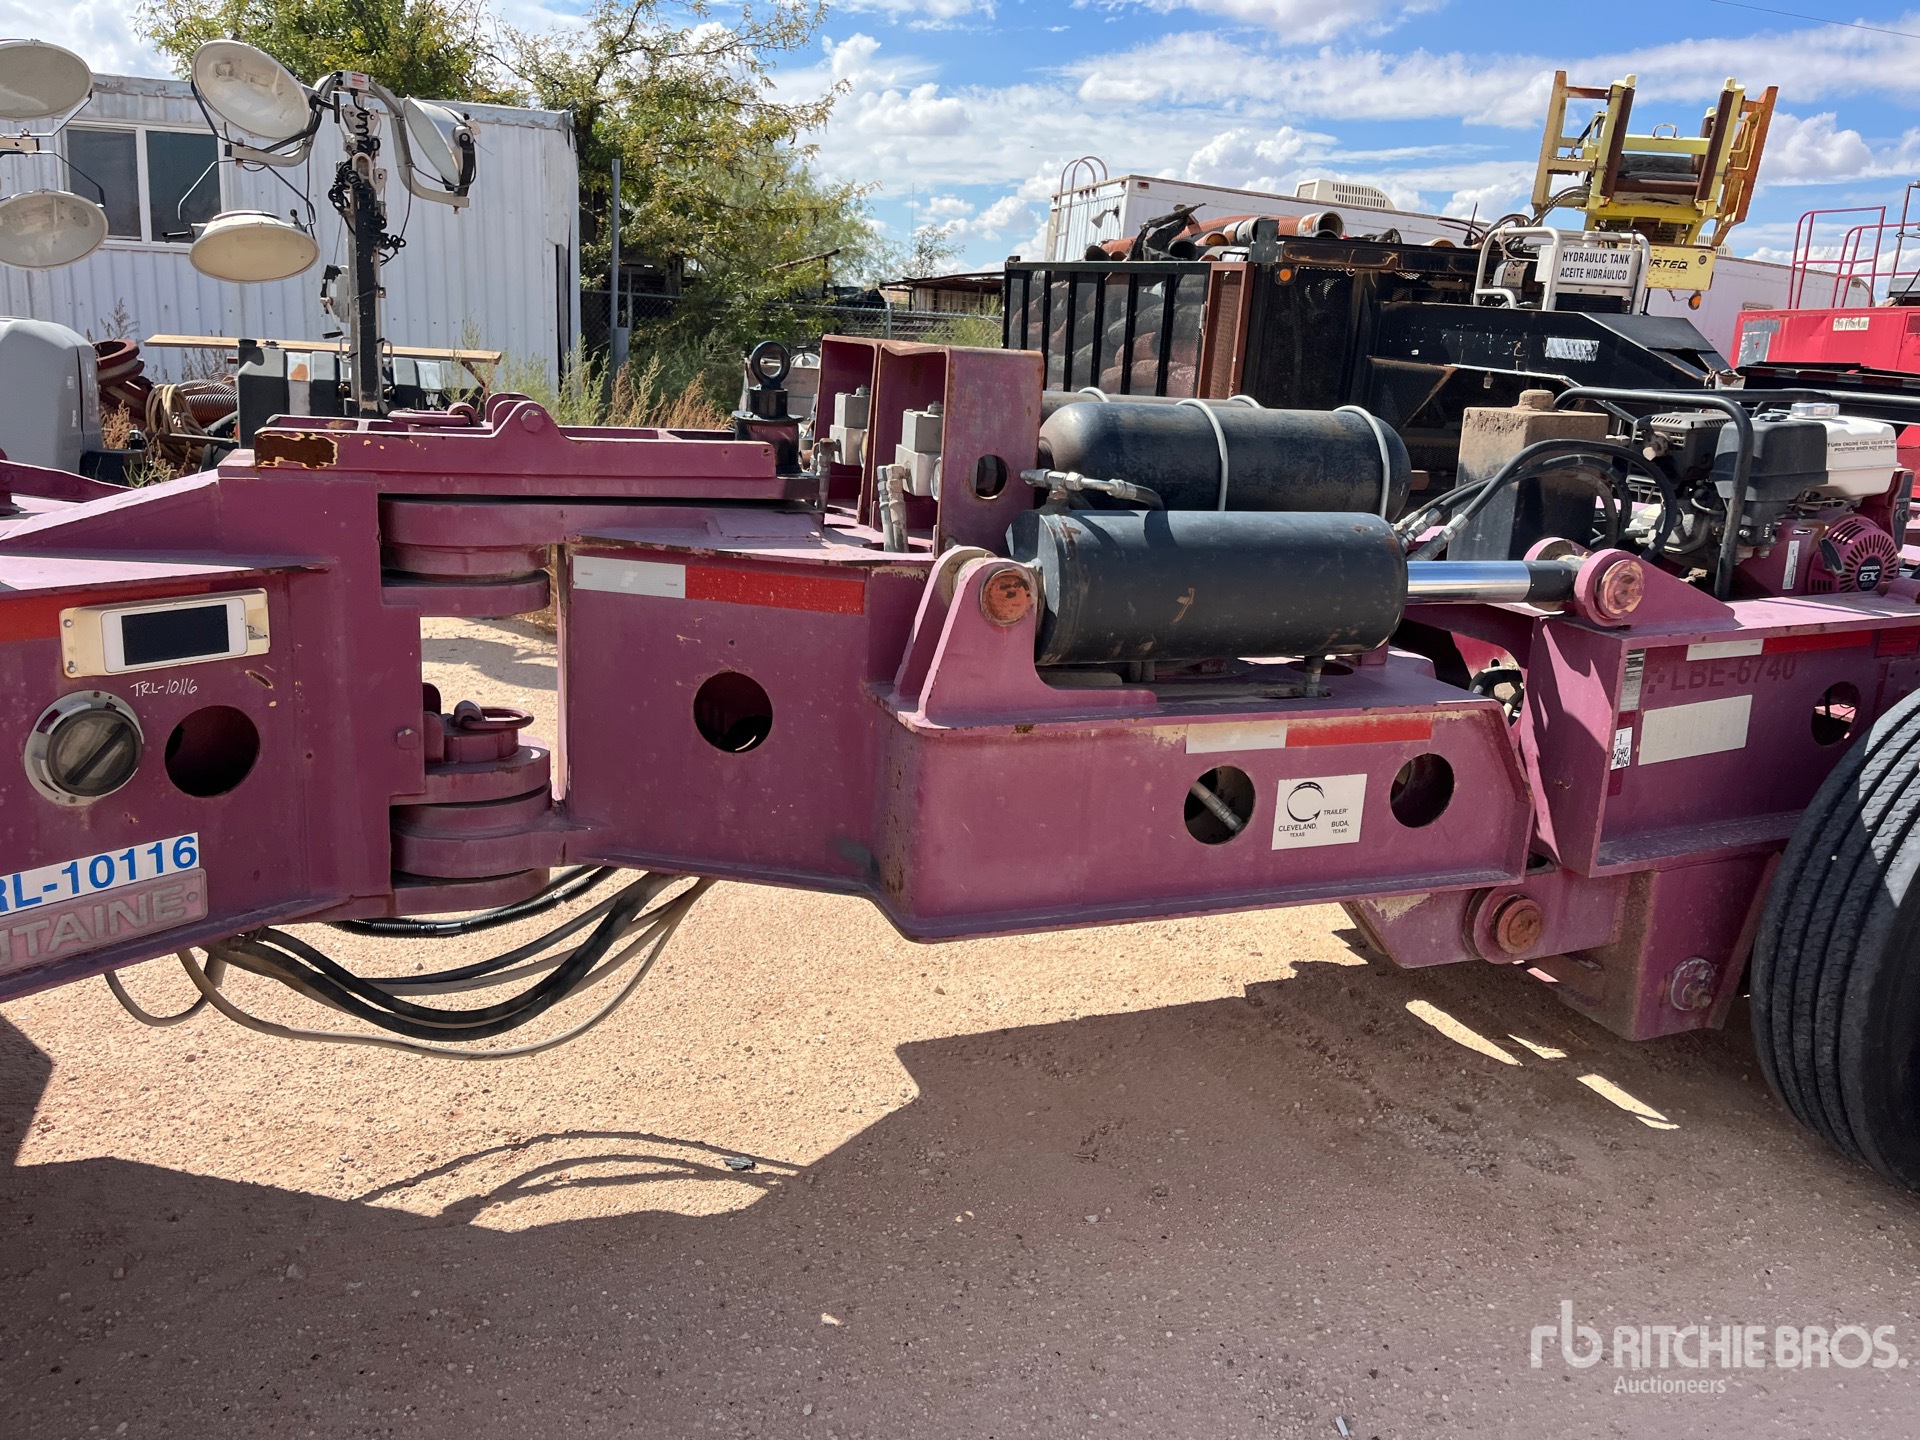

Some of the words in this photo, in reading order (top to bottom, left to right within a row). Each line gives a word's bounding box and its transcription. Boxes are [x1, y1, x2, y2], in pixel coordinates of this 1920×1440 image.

[1562, 251, 1608, 264] HYDRAULIC
[1610, 253, 1631, 265] TANK
[1560, 267, 1585, 279] ACEITE
[1859, 572, 1879, 581] GX
[1670, 655, 1796, 691] LBE-6740
[1323, 808, 1349, 816] TRAILER
